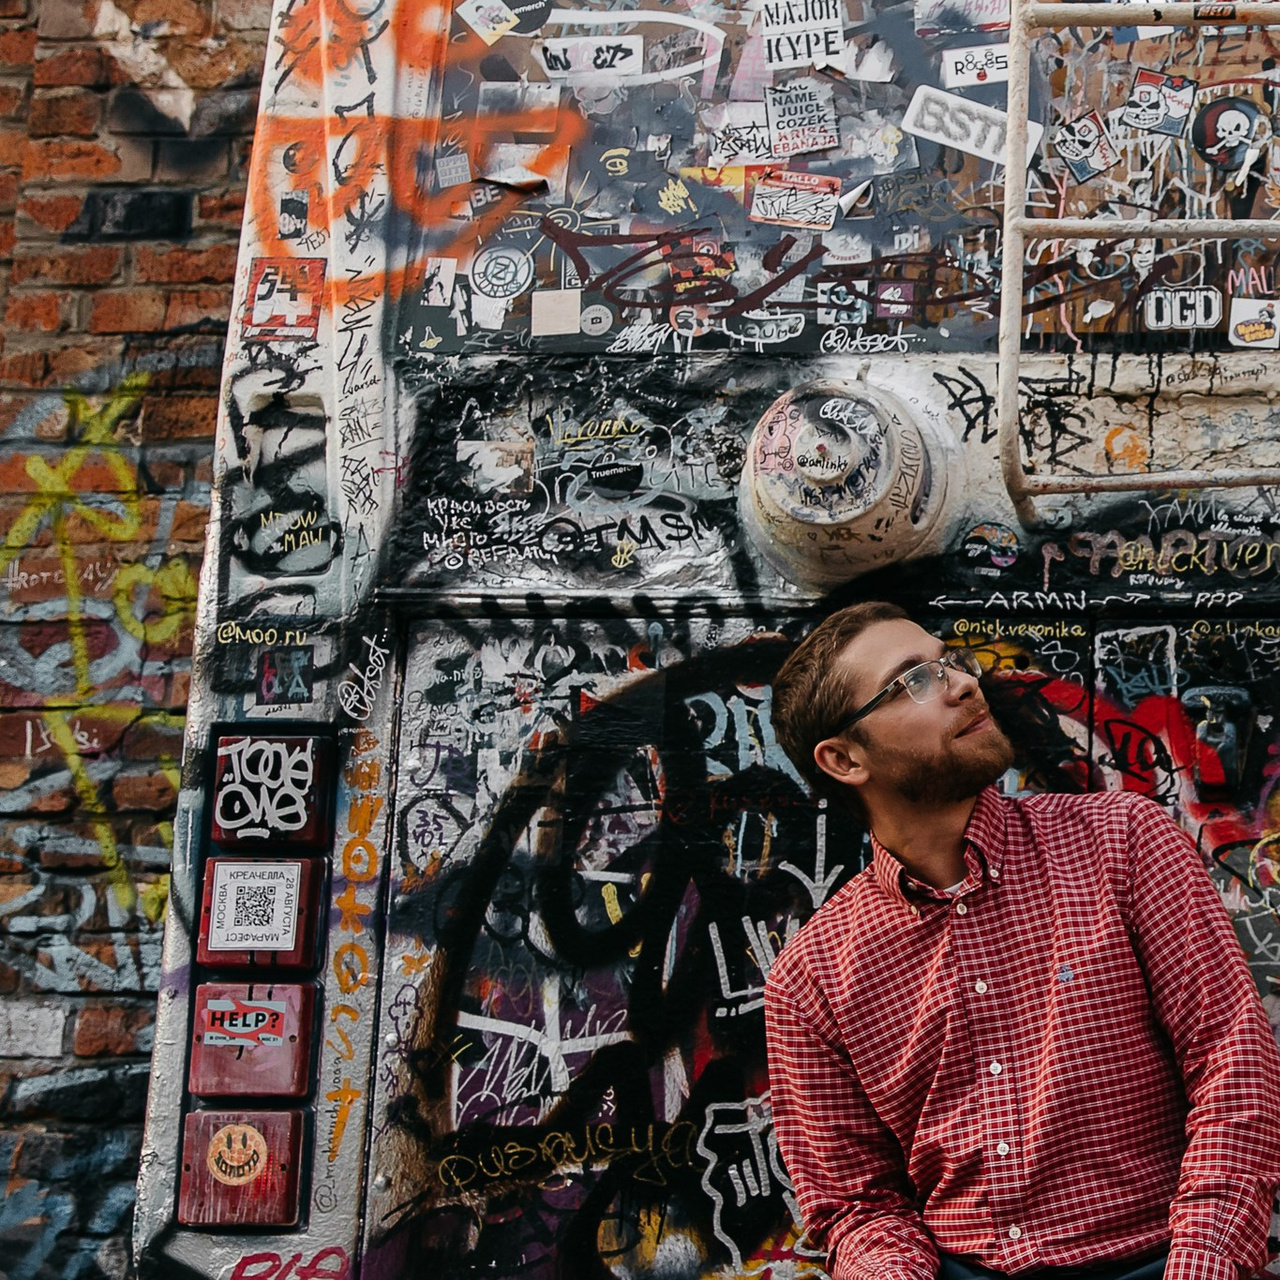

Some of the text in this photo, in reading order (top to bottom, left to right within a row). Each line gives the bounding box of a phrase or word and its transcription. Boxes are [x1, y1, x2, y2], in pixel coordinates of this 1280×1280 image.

[775, 114, 829, 131] COZEK
[773, 135, 838, 155] EBANAJA
[229, 870, 287, 881] КРЕАЧЕЛЛА
[216, 883, 228, 930] МОСКВА
[282, 877, 295, 936] 28 АВГУСТА
[224, 932, 280, 942] МАРАФЕСТ
[210, 1010, 281, 1029] HELP?
